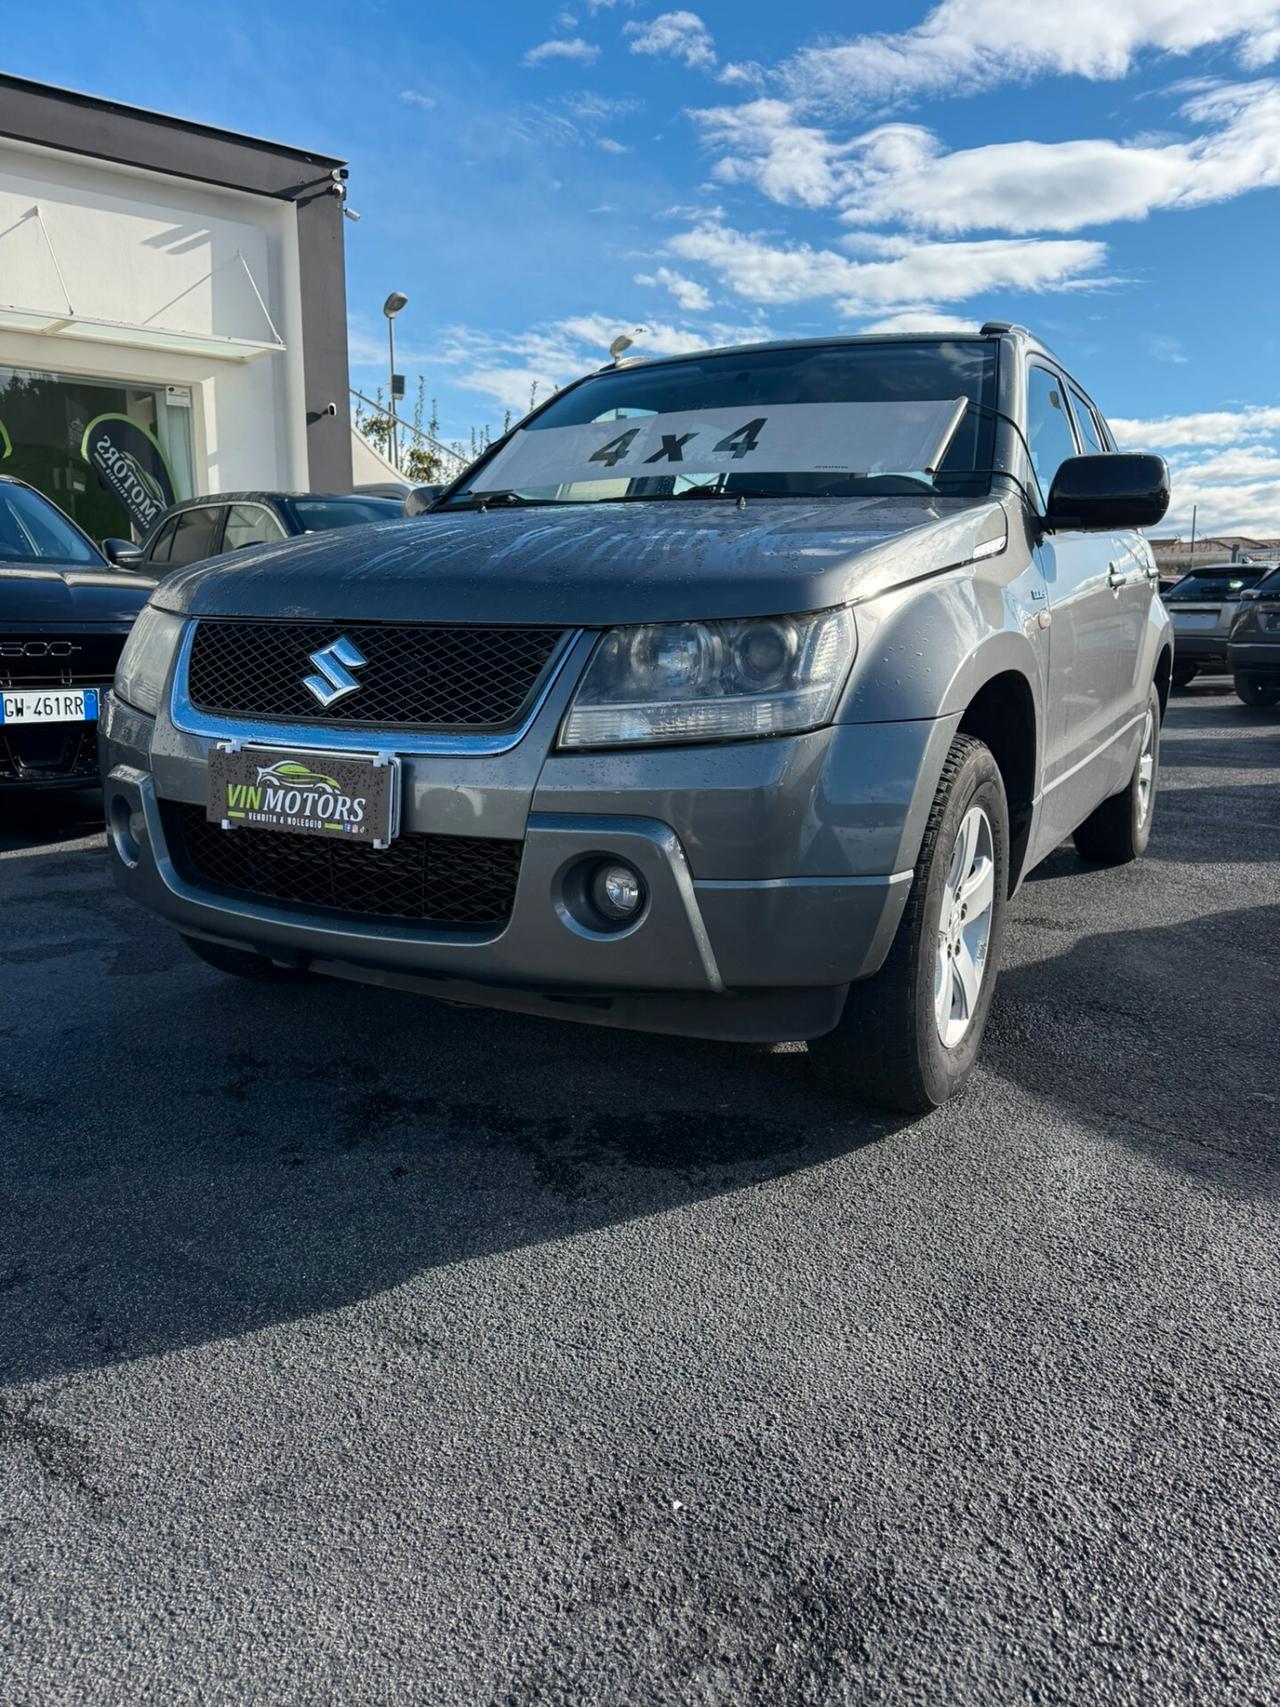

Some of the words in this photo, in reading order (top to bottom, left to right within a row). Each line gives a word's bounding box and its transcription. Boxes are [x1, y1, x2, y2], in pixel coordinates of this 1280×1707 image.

[588, 428, 641, 467] 4
[712, 418, 768, 459] 4
[227, 783, 262, 810] VIN
[262, 787, 367, 822] MOTORS
